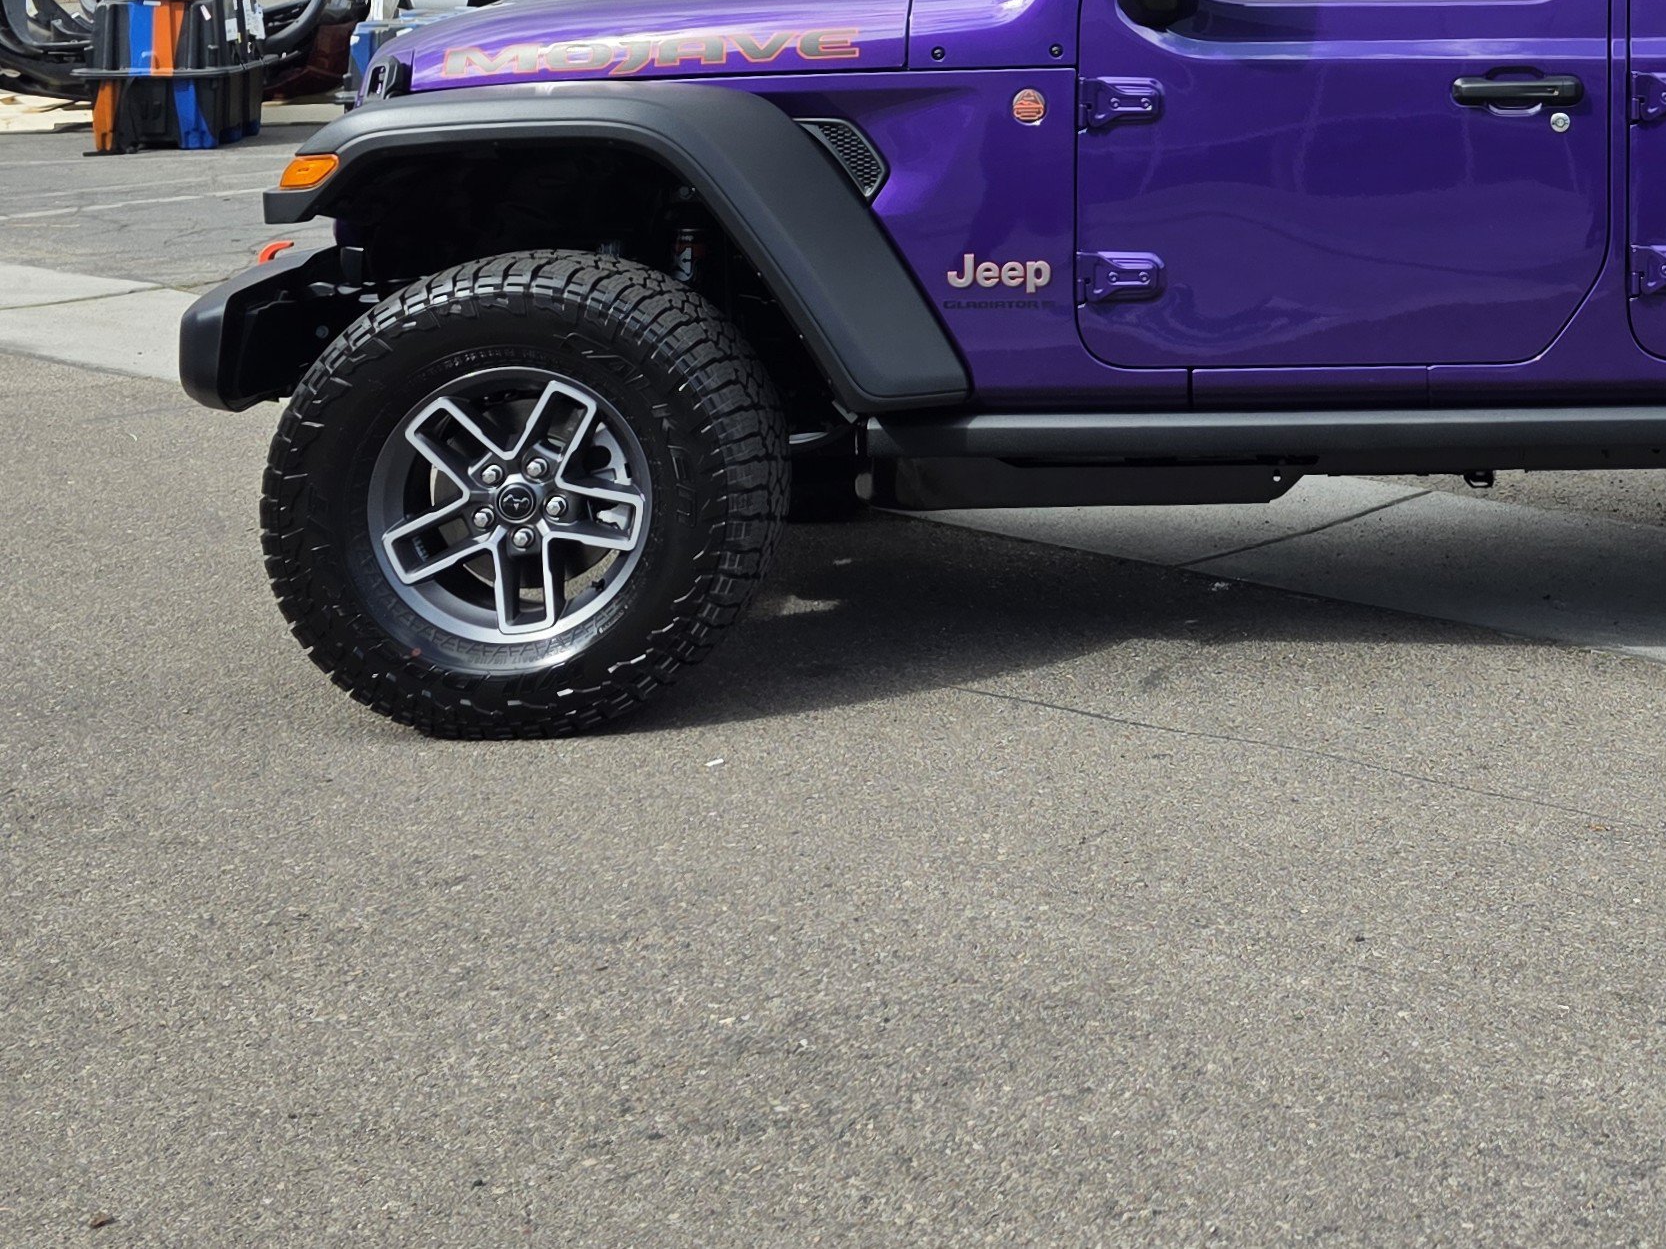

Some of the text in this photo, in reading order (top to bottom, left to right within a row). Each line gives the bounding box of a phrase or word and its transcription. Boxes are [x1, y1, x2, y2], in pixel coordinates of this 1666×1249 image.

[441, 28, 859, 77] MOJAVE
[947, 253, 1051, 293] Jeep
[943, 300, 1039, 309] GLADIATOR
